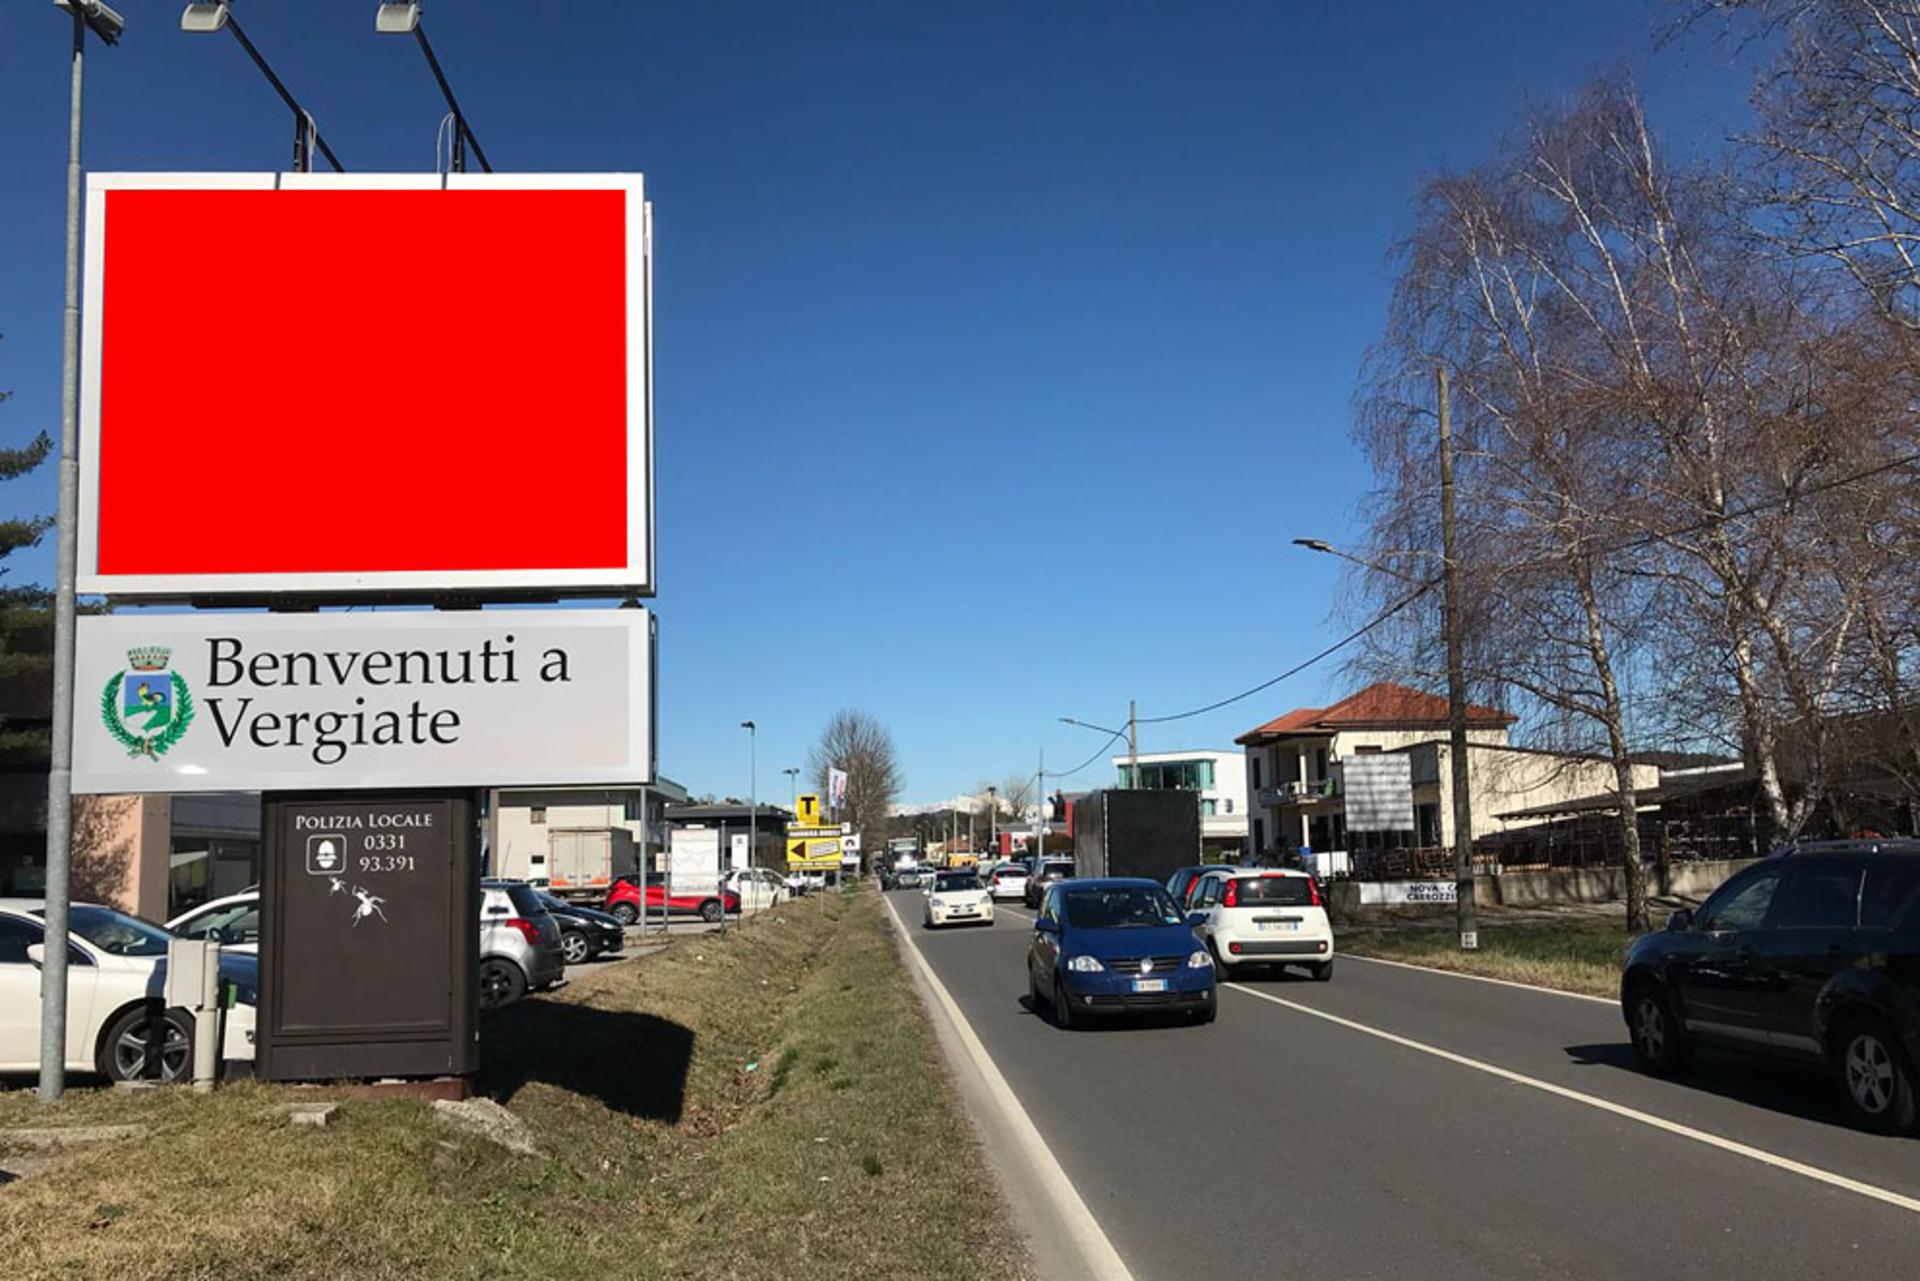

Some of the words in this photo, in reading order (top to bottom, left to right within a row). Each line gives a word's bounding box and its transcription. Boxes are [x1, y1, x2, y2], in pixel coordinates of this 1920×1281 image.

[205, 634, 520, 687] Benvenuti
[539, 648, 571, 683] a
[203, 697, 460, 765] Vergiate
[800, 796, 816, 815] T
[363, 833, 404, 850] 0331
[359, 855, 415, 872] 93.391
